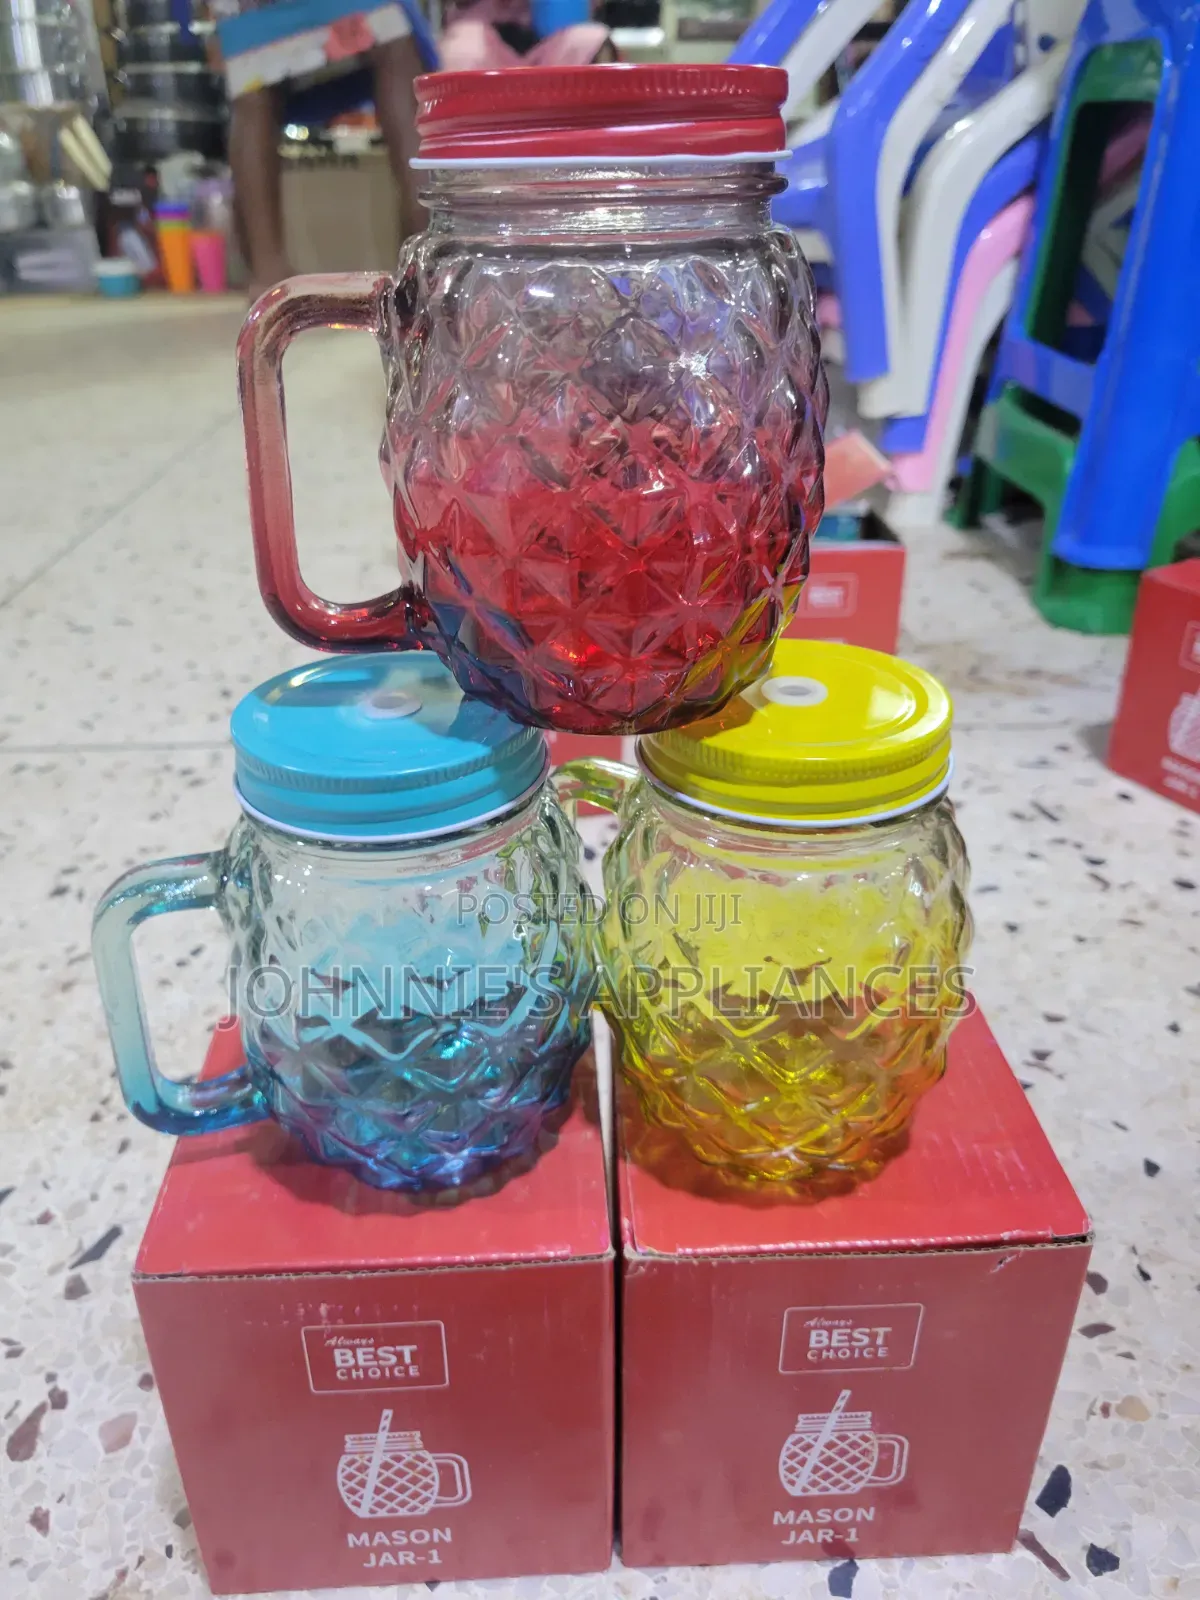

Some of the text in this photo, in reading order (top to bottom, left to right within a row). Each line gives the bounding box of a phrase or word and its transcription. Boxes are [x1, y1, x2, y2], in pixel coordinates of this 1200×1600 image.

[809, 1327, 892, 1348] BEST
[333, 1345, 417, 1368] BEST
[806, 1347, 889, 1360] CHOICE
[336, 1365, 420, 1380] CHOICE
[773, 1506, 876, 1525] MASON
[347, 1527, 453, 1548] MASON
[781, 1527, 860, 1545] JAR-1
[363, 1549, 443, 1568] JAR-1
